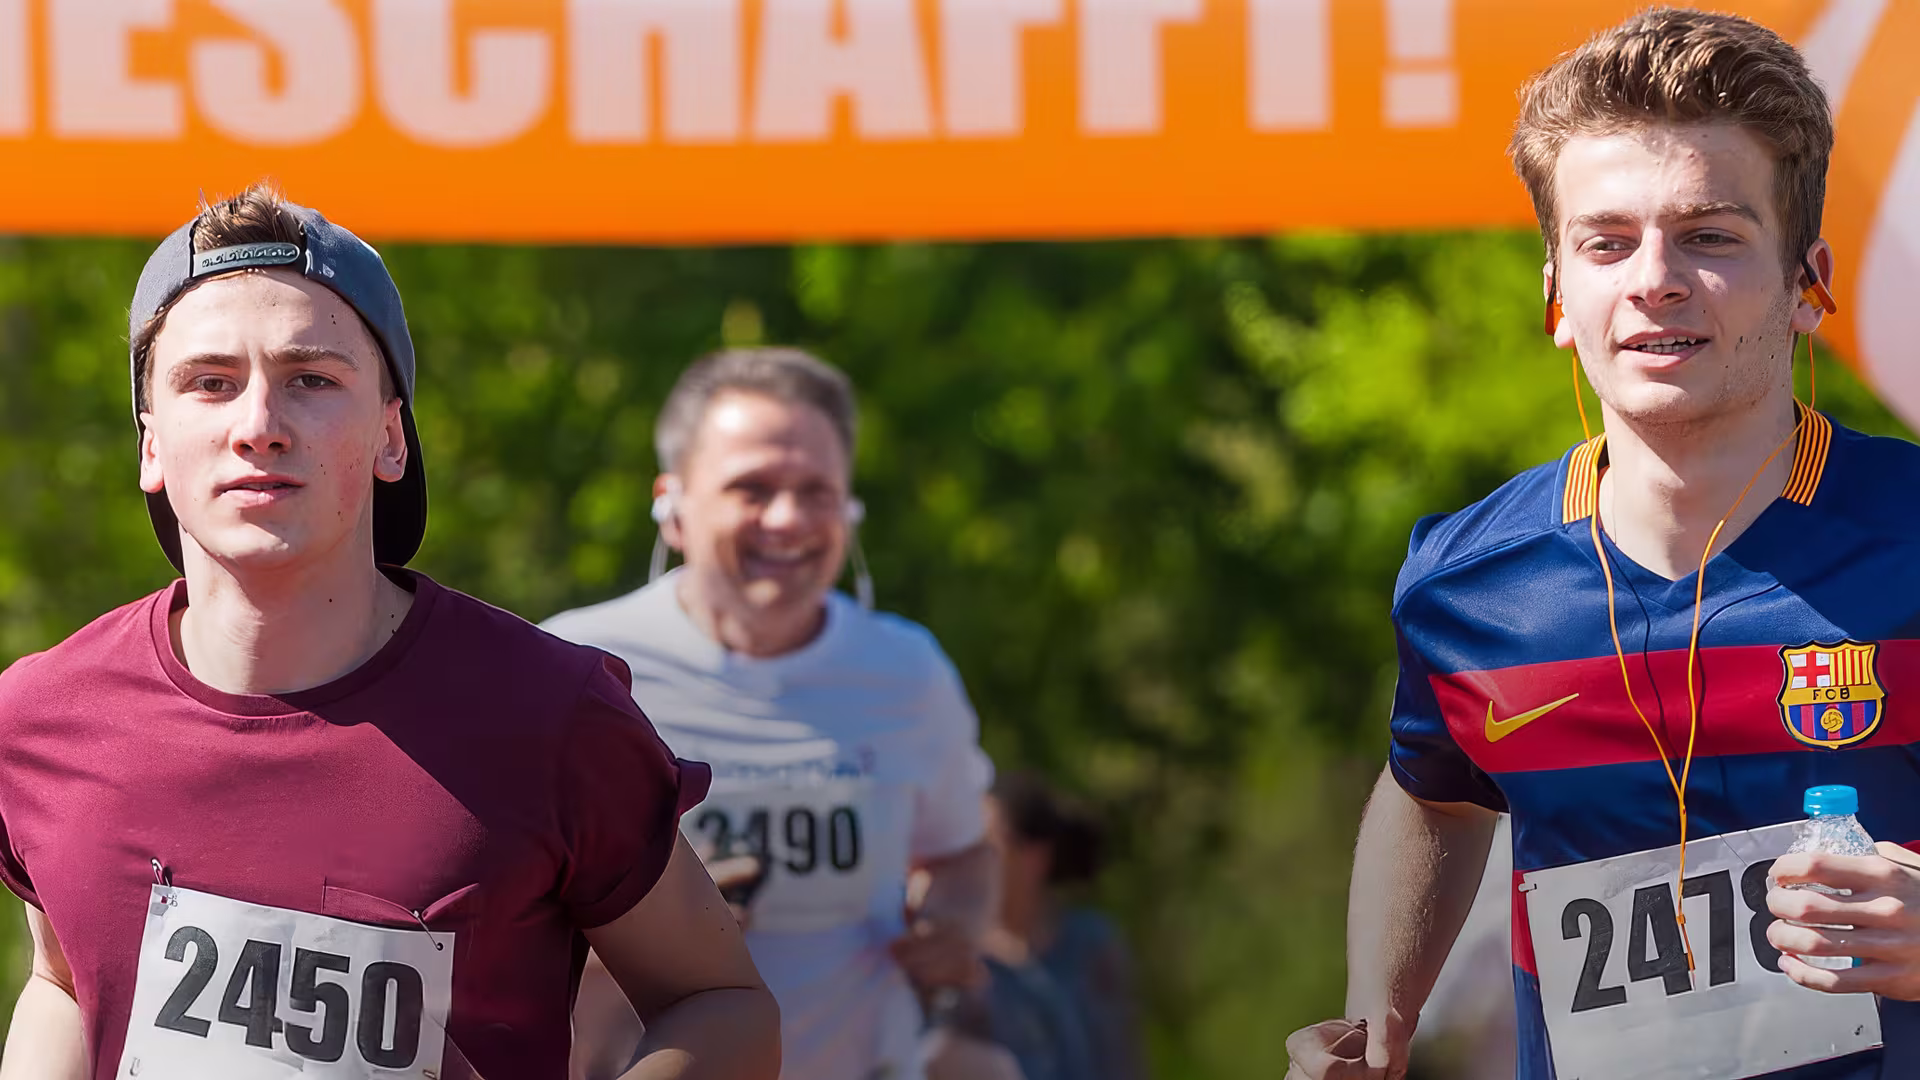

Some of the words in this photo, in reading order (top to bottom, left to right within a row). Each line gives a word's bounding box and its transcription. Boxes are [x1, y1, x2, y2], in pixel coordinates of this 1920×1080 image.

[0, 0, 1459, 148] ESCHAFF!
[1812, 686, 1851, 701] FCB
[154, 925, 424, 1070] 2450
